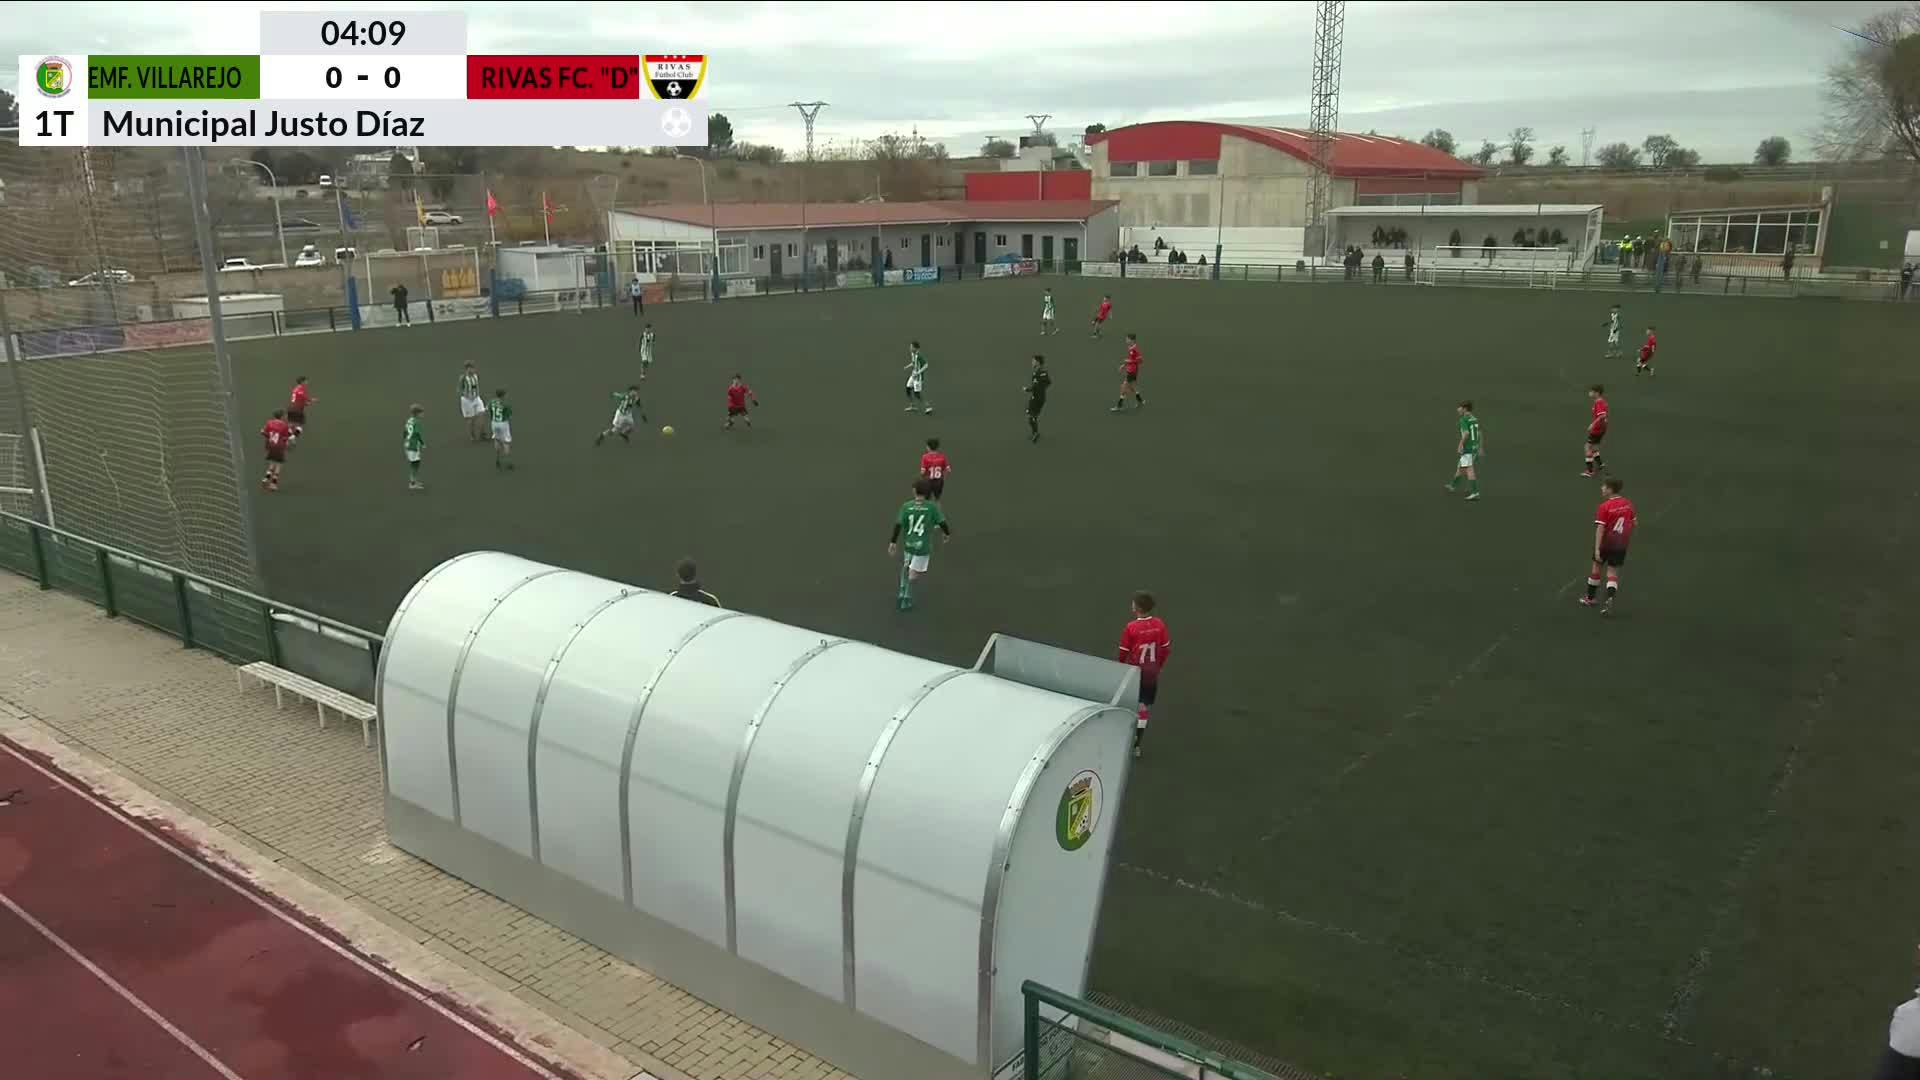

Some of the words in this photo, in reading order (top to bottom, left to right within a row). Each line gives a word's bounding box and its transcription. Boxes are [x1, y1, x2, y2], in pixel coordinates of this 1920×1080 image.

[492, 407, 503, 421] 15
[928, 466, 942, 479] 16
[907, 514, 925, 536] 14
[1613, 516, 1625, 534] 4
[1139, 641, 1156, 663] 71
